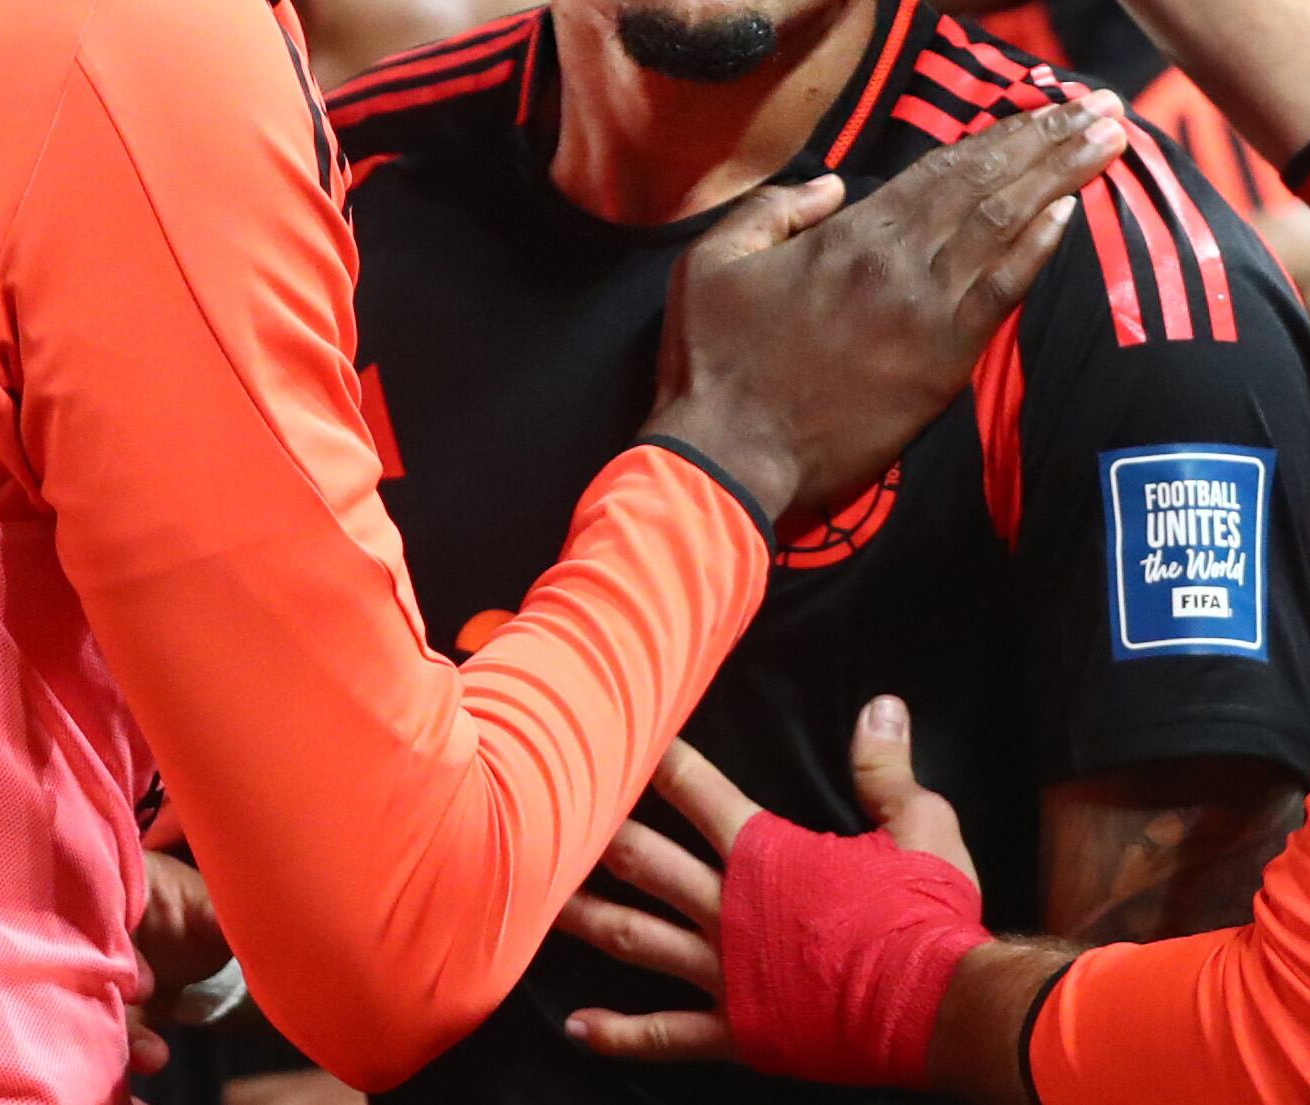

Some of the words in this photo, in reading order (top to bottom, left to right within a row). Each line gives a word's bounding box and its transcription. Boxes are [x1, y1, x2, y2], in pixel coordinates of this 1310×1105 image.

[1144, 479, 1241, 510] FOOTBALL
[1146, 508, 1242, 549] UNITES
[1139, 549, 1183, 584] the
[1185, 548, 1246, 586] World
[1180, 594, 1221, 609] FIFA
